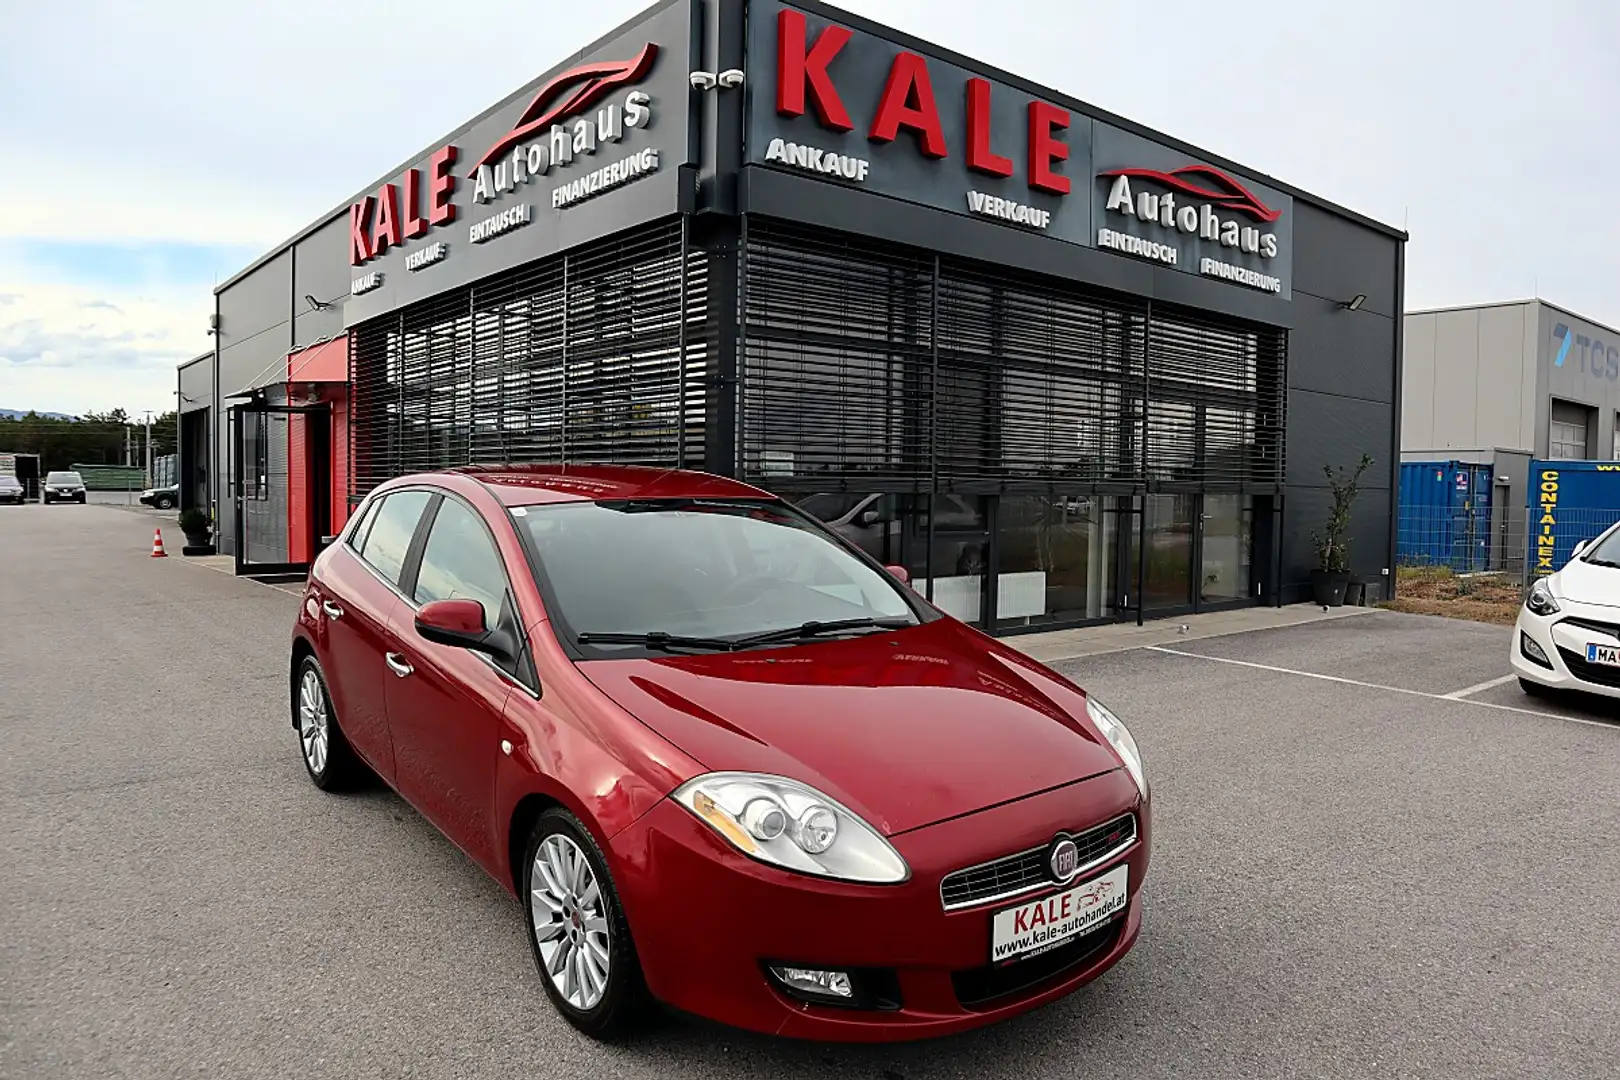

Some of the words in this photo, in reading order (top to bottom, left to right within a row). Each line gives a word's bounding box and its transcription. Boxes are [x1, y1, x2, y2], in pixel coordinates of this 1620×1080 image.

[776, 8, 1070, 196] KALE
[473, 90, 650, 204] Autohaus
[764, 137, 869, 183] ANKAUF
[552, 147, 659, 209] FINANZIERUNG
[350, 145, 457, 266] KALE
[469, 204, 532, 244] EINTAUSCH
[966, 190, 1051, 229] VERKAUF
[1106, 174, 1278, 259] Autohaus
[405, 241, 447, 272] VERKAUF
[1098, 228, 1177, 265] EINTAUSCH
[1200, 257, 1281, 293] FINANZIERUNG
[1577, 333, 1619, 382] TCS
[1538, 471, 1560, 567] CONTAINEX
[994, 892, 1126, 957] www.kale-autohandel.at
[1013, 893, 1072, 935] KALE
